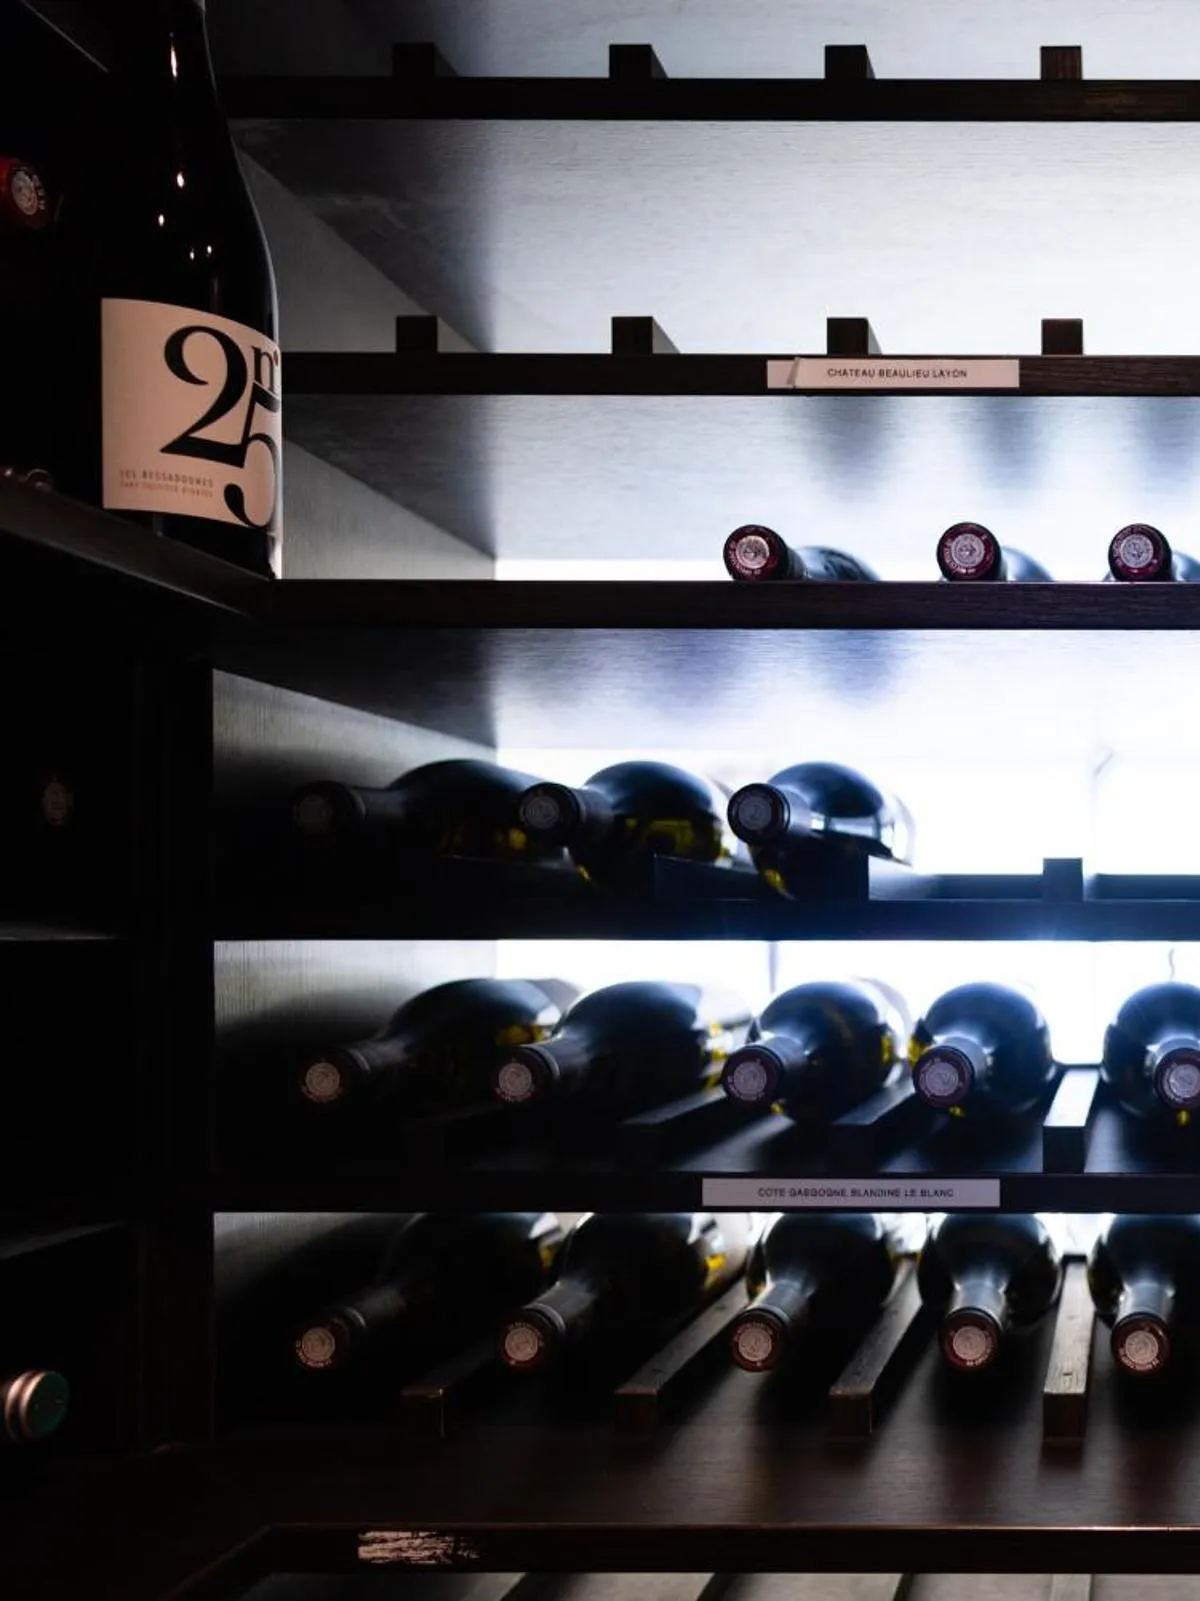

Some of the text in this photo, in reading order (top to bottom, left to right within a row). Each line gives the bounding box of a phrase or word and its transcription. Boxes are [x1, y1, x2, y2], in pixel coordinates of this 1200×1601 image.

[827, 367, 968, 378] CHATEAU BEAULIEU LAYON
[757, 1187, 786, 1198] COTE
[850, 1187, 900, 1198] BLANDINE
[904, 1187, 916, 1198] LE
[920, 1187, 954, 1198] BLANC
